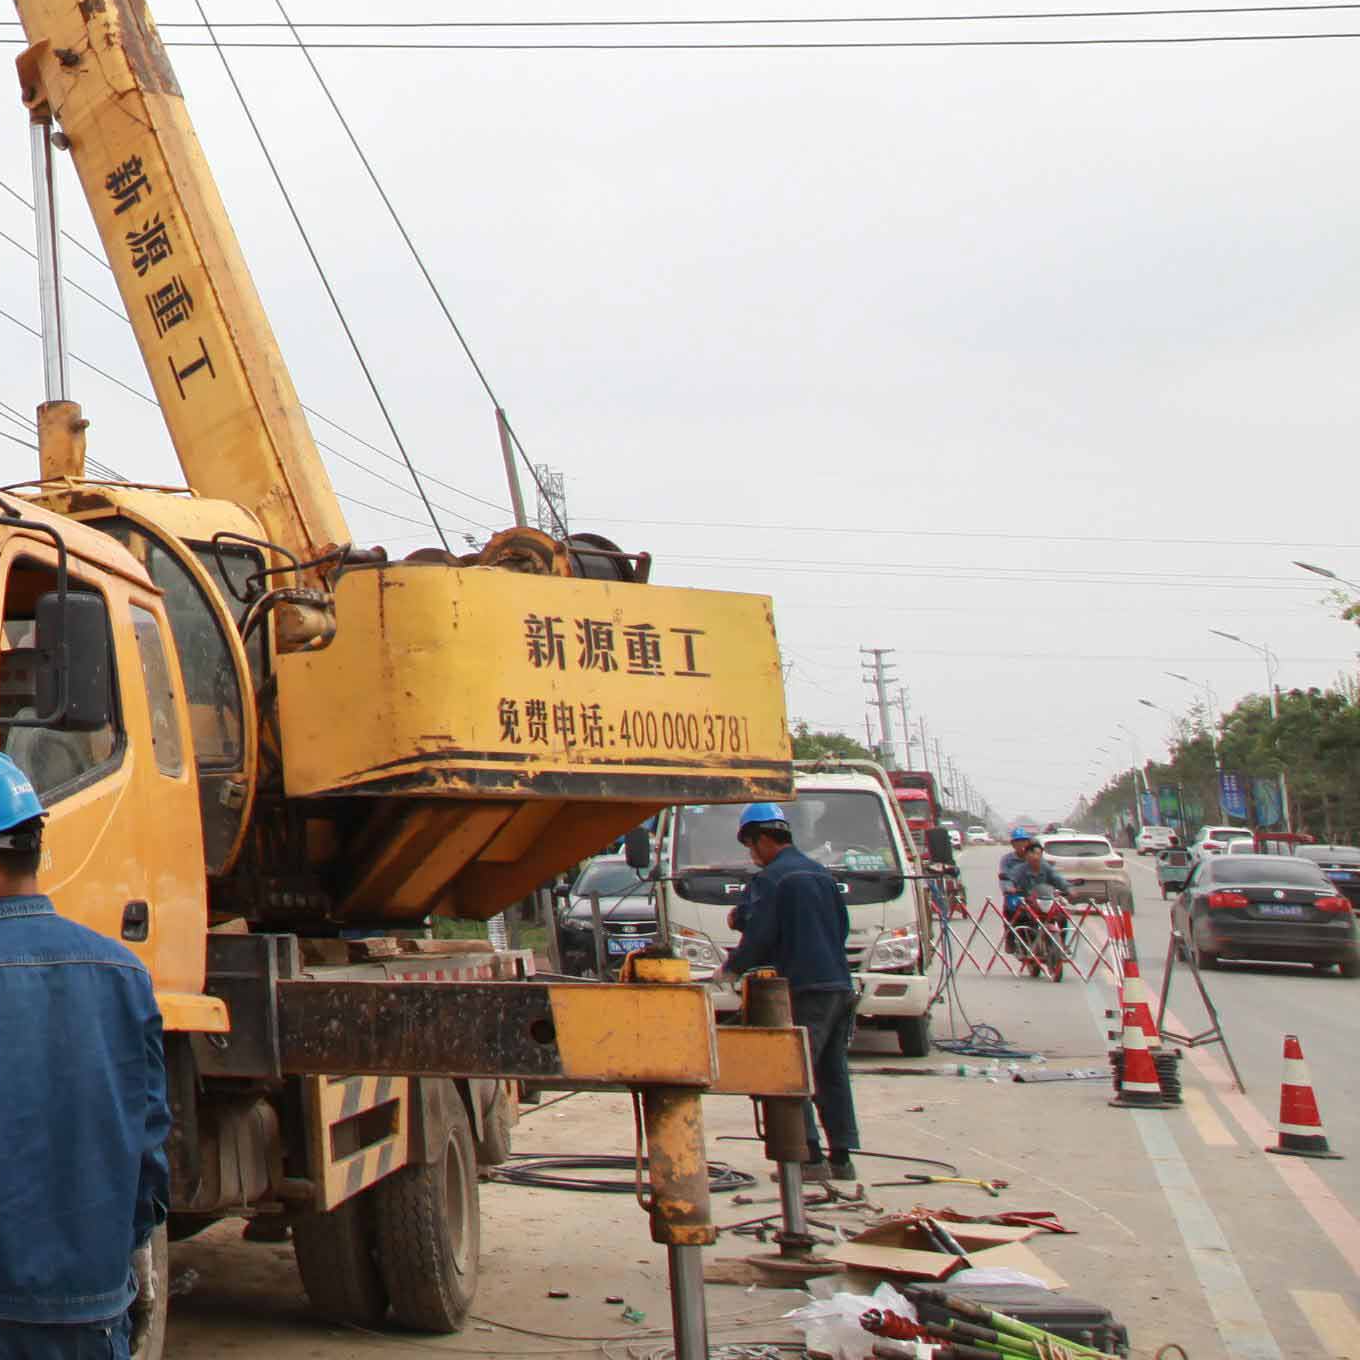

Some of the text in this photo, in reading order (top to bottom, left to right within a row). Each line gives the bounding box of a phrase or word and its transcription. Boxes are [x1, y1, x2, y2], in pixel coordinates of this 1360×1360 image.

[104, 153, 216, 401] 新源重工
[523, 613, 711, 678] 新源重工
